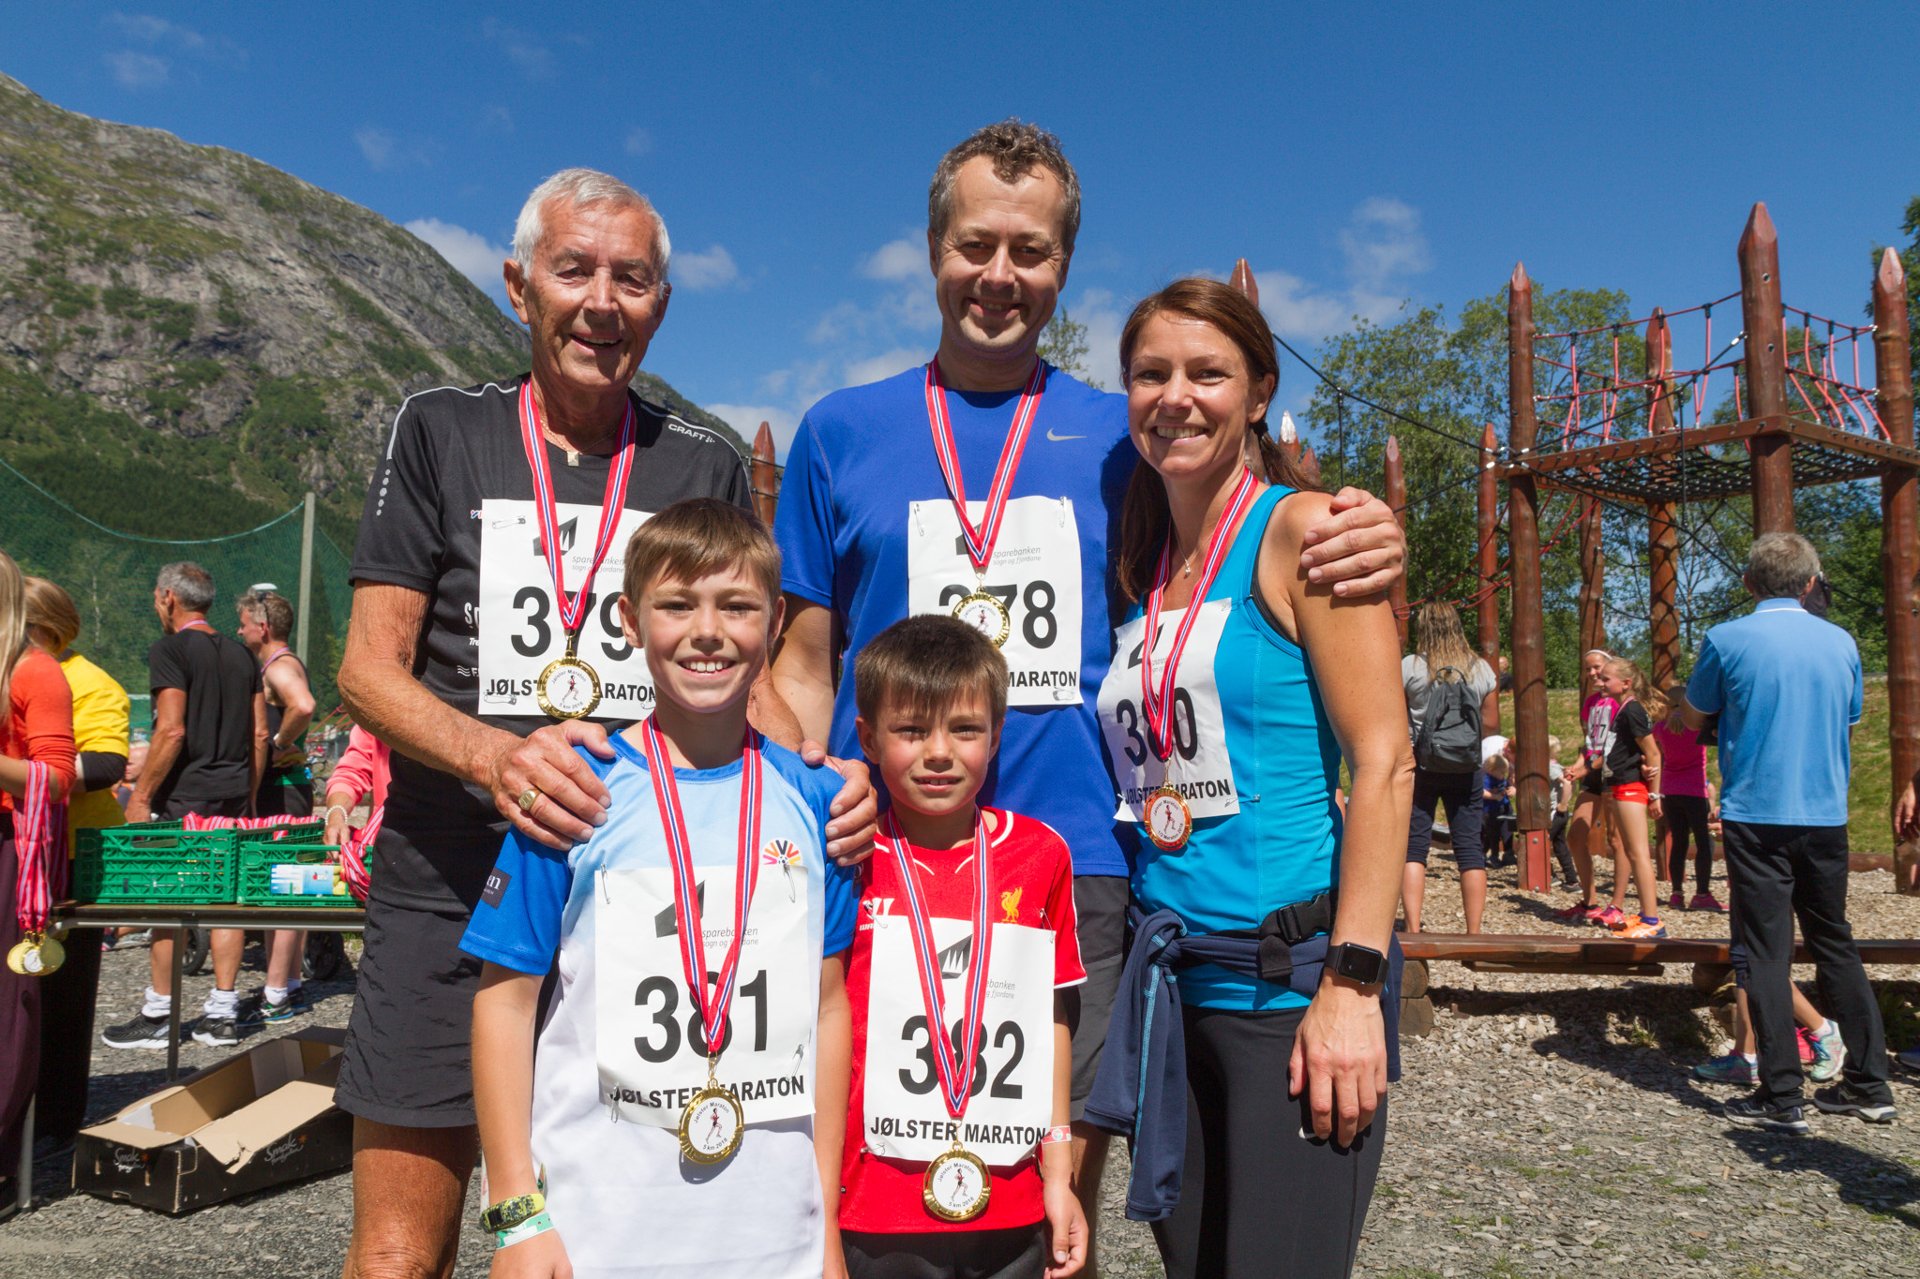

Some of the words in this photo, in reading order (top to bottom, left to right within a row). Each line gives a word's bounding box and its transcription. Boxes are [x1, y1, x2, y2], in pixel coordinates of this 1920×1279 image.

[668, 423, 706, 440] CRAFT
[571, 555, 624, 567] sparenken
[511, 586, 634, 662] 379
[487, 679, 539, 697] JØLS
[601, 682, 657, 701] RATON
[1125, 784, 1161, 805] JØLST
[1170, 779, 1232, 800] ARATON
[702, 926, 759, 940] sparebaen
[987, 978, 1017, 991] banken
[634, 970, 768, 1063] 381
[899, 1015, 1025, 1099] 382
[719, 1075, 805, 1101] ARATON
[871, 1117, 957, 1141] JØLSTER
[965, 1123, 1046, 1146] MARATON
